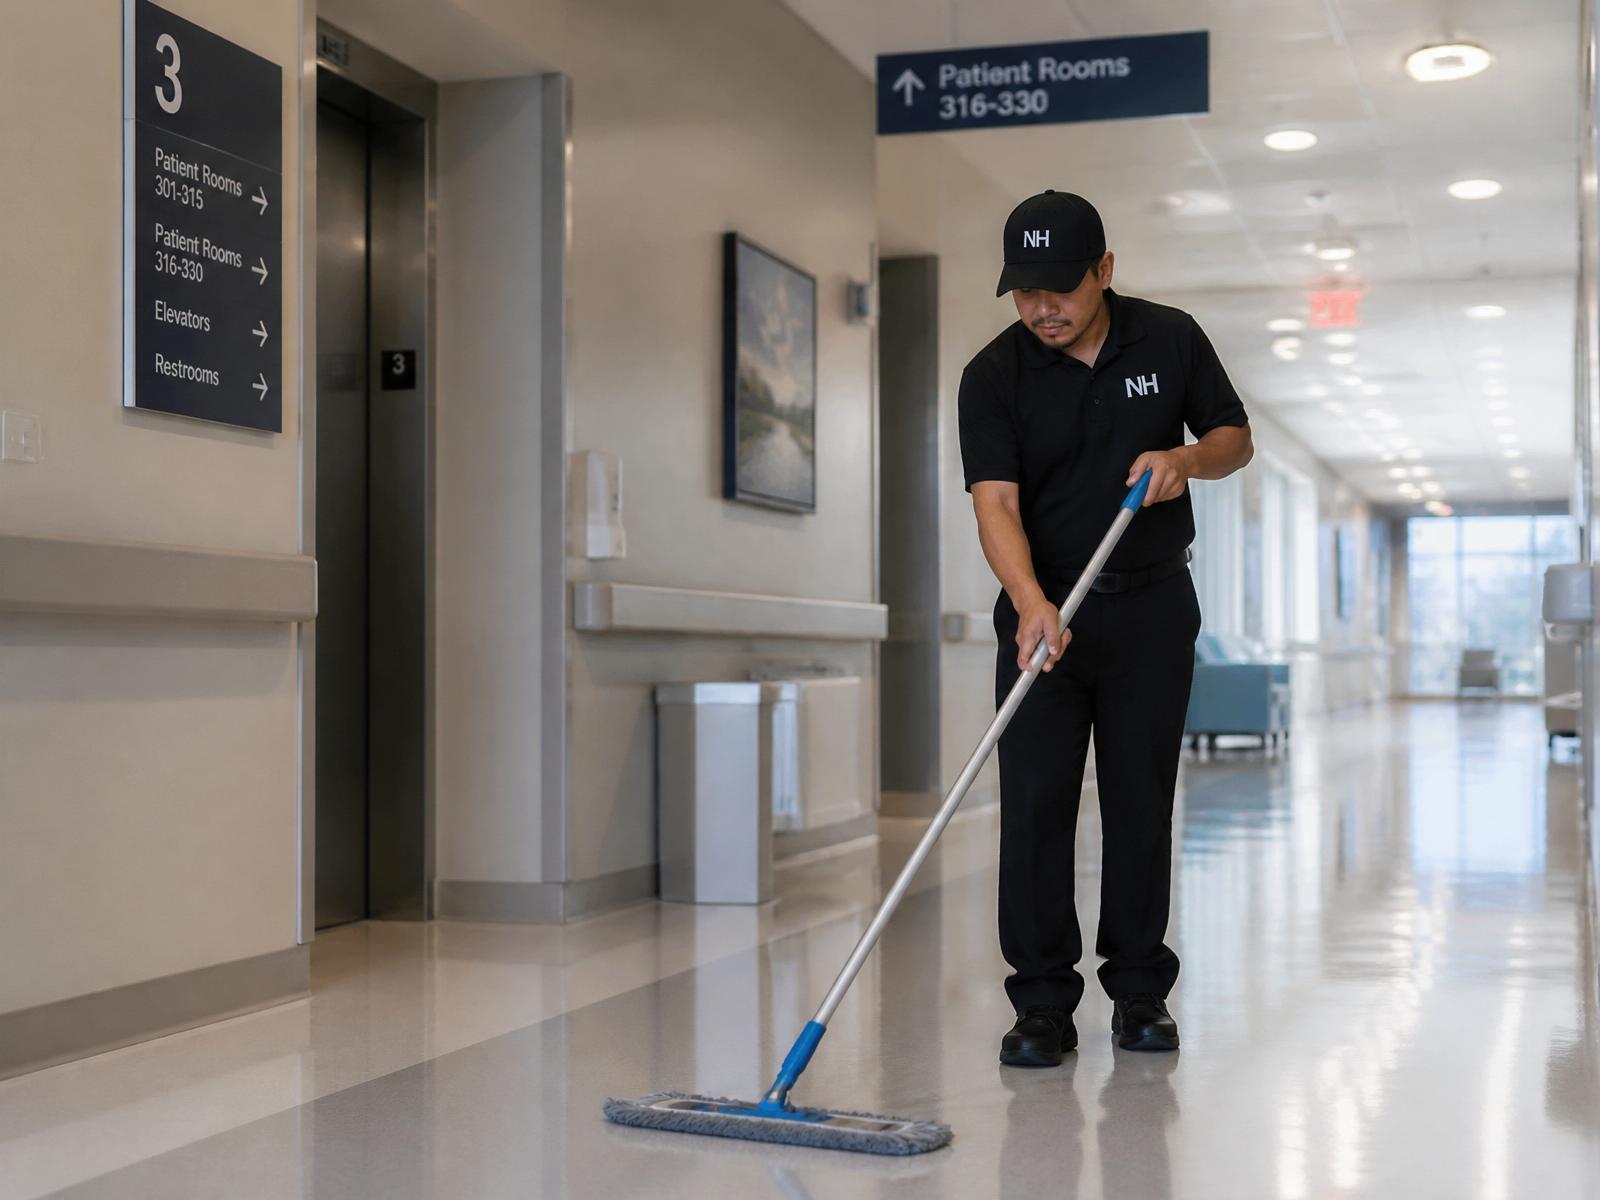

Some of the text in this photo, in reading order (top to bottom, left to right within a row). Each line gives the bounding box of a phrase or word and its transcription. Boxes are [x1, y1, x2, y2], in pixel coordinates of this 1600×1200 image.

[155, 33, 183, 114] 3
[938, 56, 1131, 89] Patient Rooms
[938, 89, 1049, 120] 316-330
[155, 147, 243, 197] Patient Rooms
[155, 175, 204, 210] 301-315
[155, 223, 243, 268] Patient Rooms
[1023, 229, 1050, 248] NH
[155, 250, 204, 283] 316-330
[155, 300, 211, 333] Elevators
[155, 353, 220, 386] Restrooms
[392, 353, 405, 375] 3
[1124, 373, 1160, 398] NH
